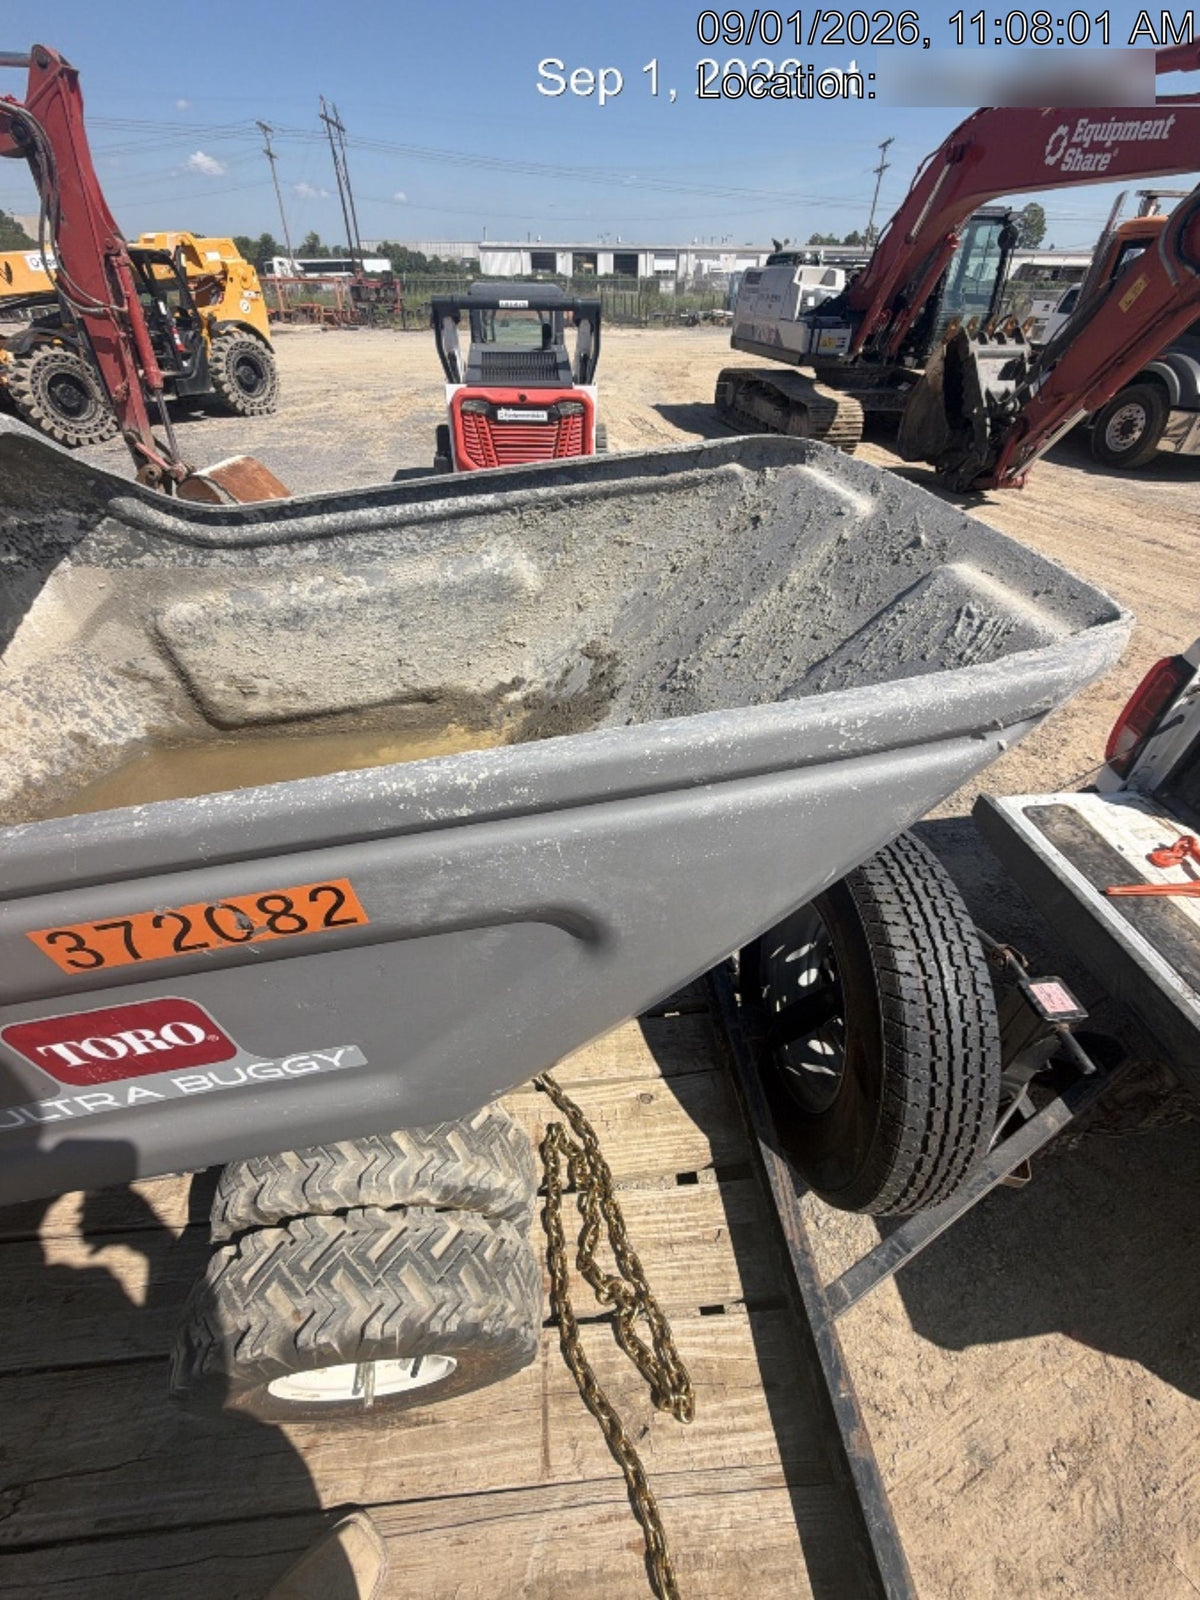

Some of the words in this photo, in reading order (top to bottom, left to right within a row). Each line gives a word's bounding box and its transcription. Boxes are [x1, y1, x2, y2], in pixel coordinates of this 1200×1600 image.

[1071, 113, 1177, 148] Equipment
[1060, 147, 1112, 172] Share
[46, 885, 358, 970] 372082
[36, 1021, 206, 1068] TORO
[171, 1048, 346, 1093] BUGGY
